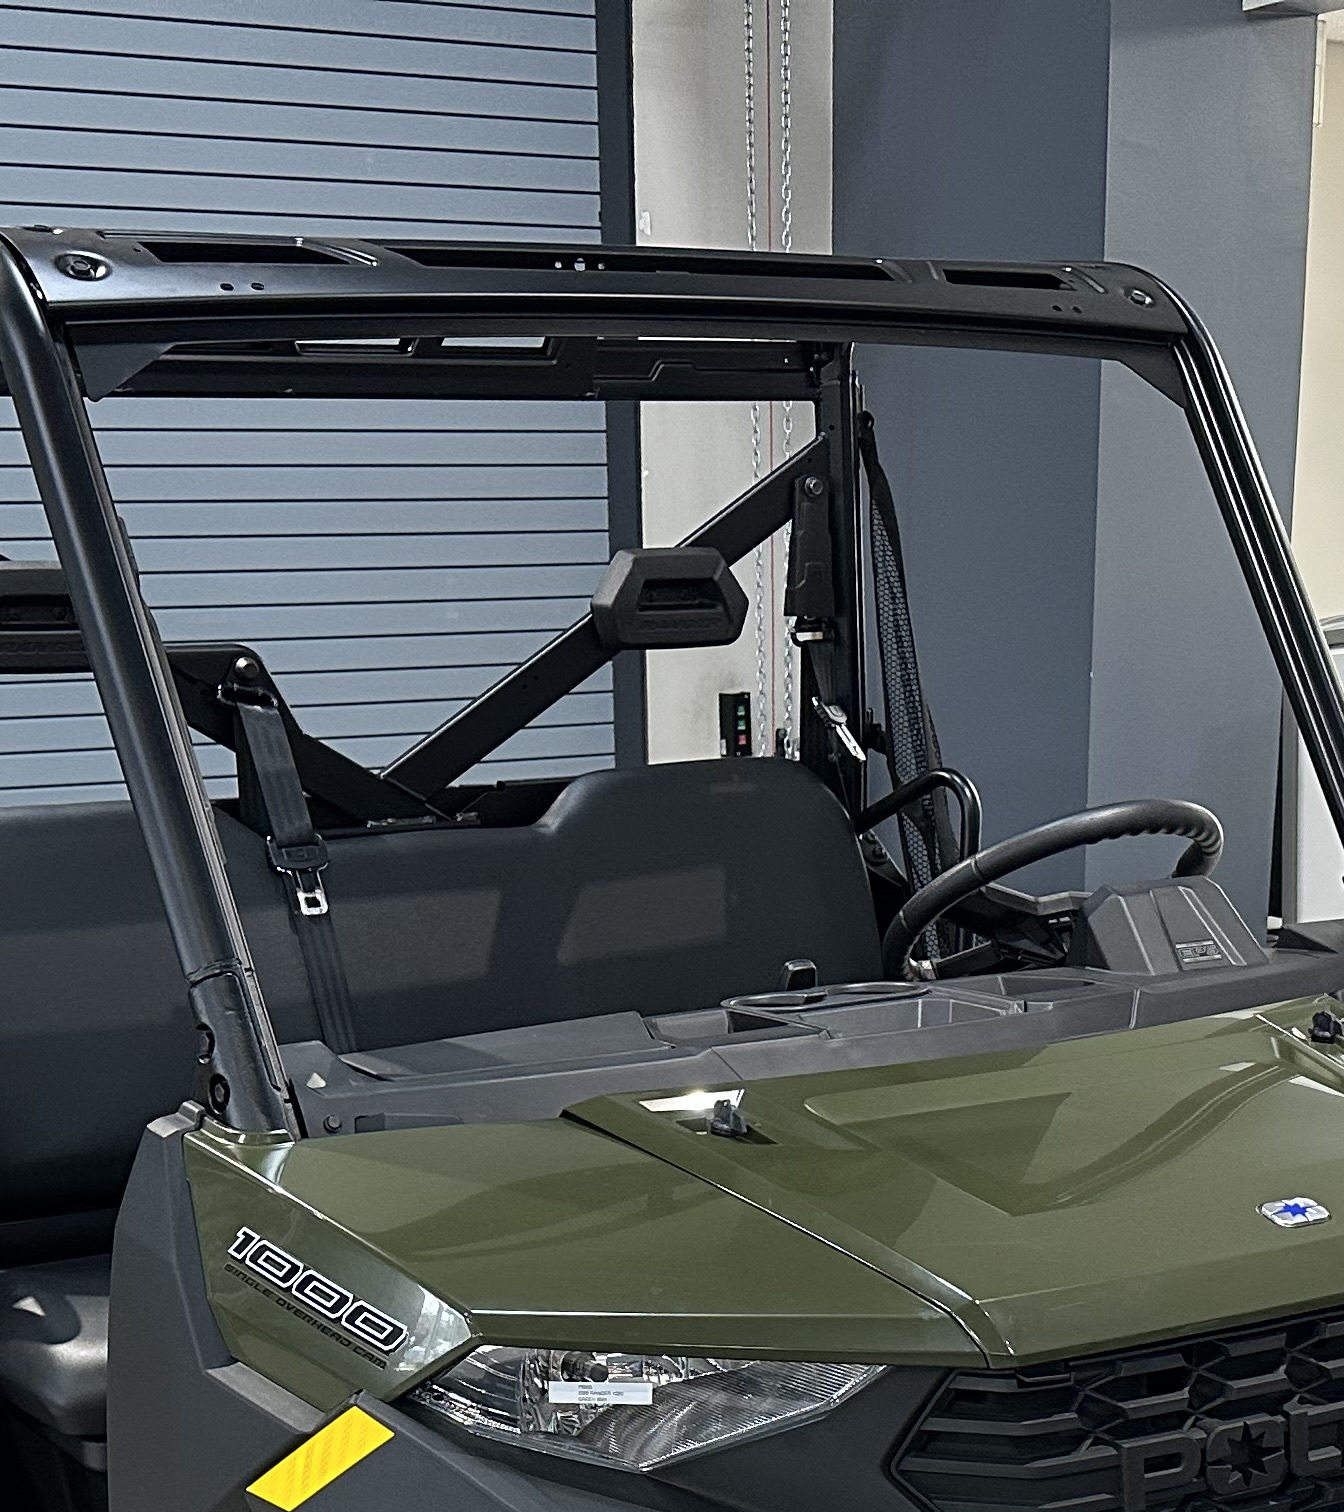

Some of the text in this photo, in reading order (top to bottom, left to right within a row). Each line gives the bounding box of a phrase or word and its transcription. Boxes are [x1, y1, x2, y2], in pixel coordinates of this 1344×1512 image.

[223, 1263, 387, 1370] SINGLE OVERHEAD CAM
[227, 1226, 409, 1356] 1000
